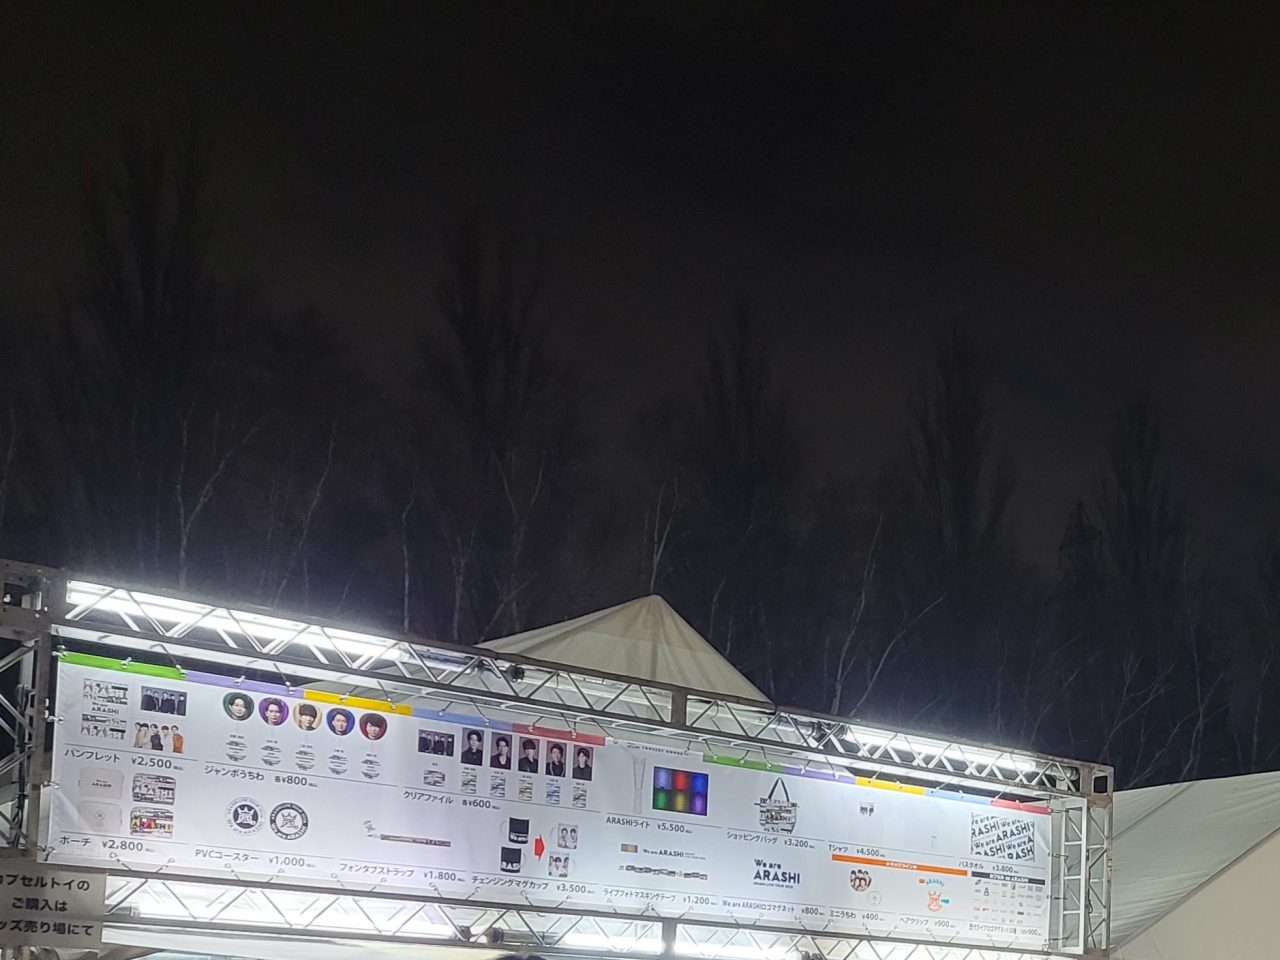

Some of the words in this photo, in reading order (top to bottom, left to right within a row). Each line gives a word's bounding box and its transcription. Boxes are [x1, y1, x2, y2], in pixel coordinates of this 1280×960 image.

[64, 748, 120, 763] パンフレット
[132, 757, 172, 769] ¥2,500
[204, 766, 265, 781] ジャンボうちわ
[403, 790, 454, 804] クリアファイル
[606, 816, 650, 829] ARASHIライト
[657, 823, 685, 833] ¥5,500
[996, 822, 1031, 843] ARASHI
[102, 840, 143, 852] ¥2,800
[726, 832, 778, 844] ショッピングバッグ
[784, 838, 809, 848] ¥3,200
[659, 850, 685, 858] ARASHI
[828, 844, 849, 853] Tシャツ
[856, 848, 880, 857] ¥4,500
[195, 849, 259, 863] PVCコースター
[269, 856, 305, 867] ¥1,000
[754, 859, 767, 868] We
[768, 862, 782, 870] are
[424, 870, 456, 881] ¥1,800
[754, 869, 800, 885] ARASHI
[471, 877, 549, 890] チェンジングマグカップ
[556, 883, 586, 893] ¥3,500
[12, 897, 68, 912] ご購入は
[683, 895, 709, 905] ¥1,200
[801, 906, 819, 916] ¥800
[862, 912, 879, 921] ¥400
